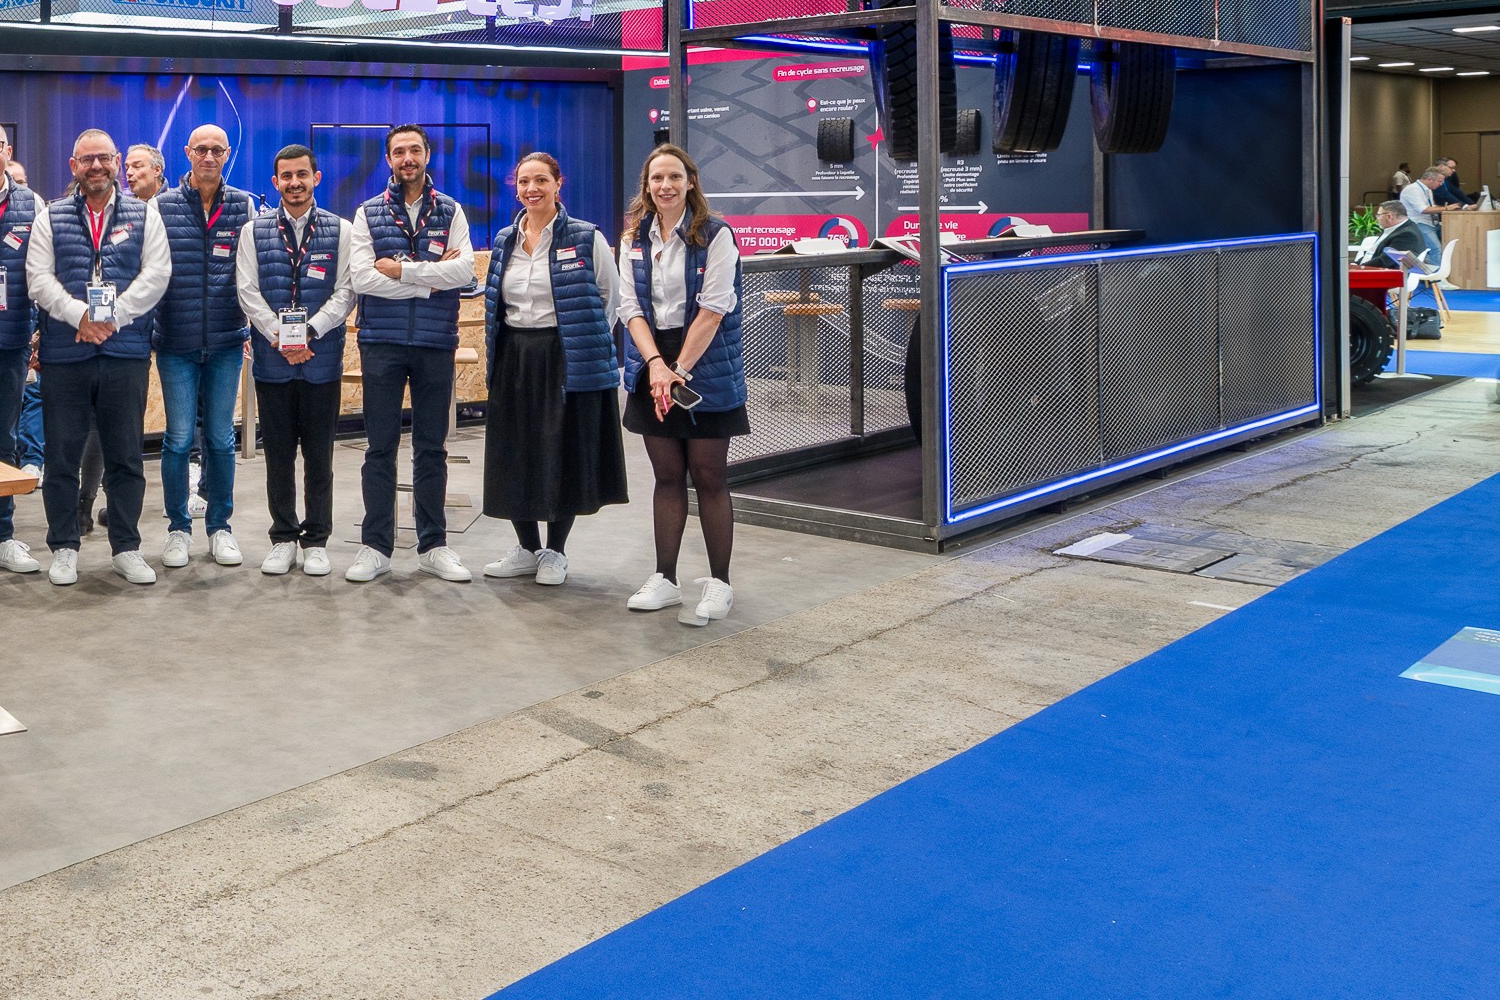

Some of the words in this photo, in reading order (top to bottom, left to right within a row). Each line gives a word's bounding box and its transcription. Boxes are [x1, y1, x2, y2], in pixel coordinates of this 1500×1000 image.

[796, 68, 813, 78] cycle
[829, 65, 865, 74] recreusage
[653, 78, 670, 87] Début
[944, 220, 959, 230] vie
[752, 226, 796, 236] recreusage
[740, 237, 757, 247] 175
[758, 236, 778, 247] 000
